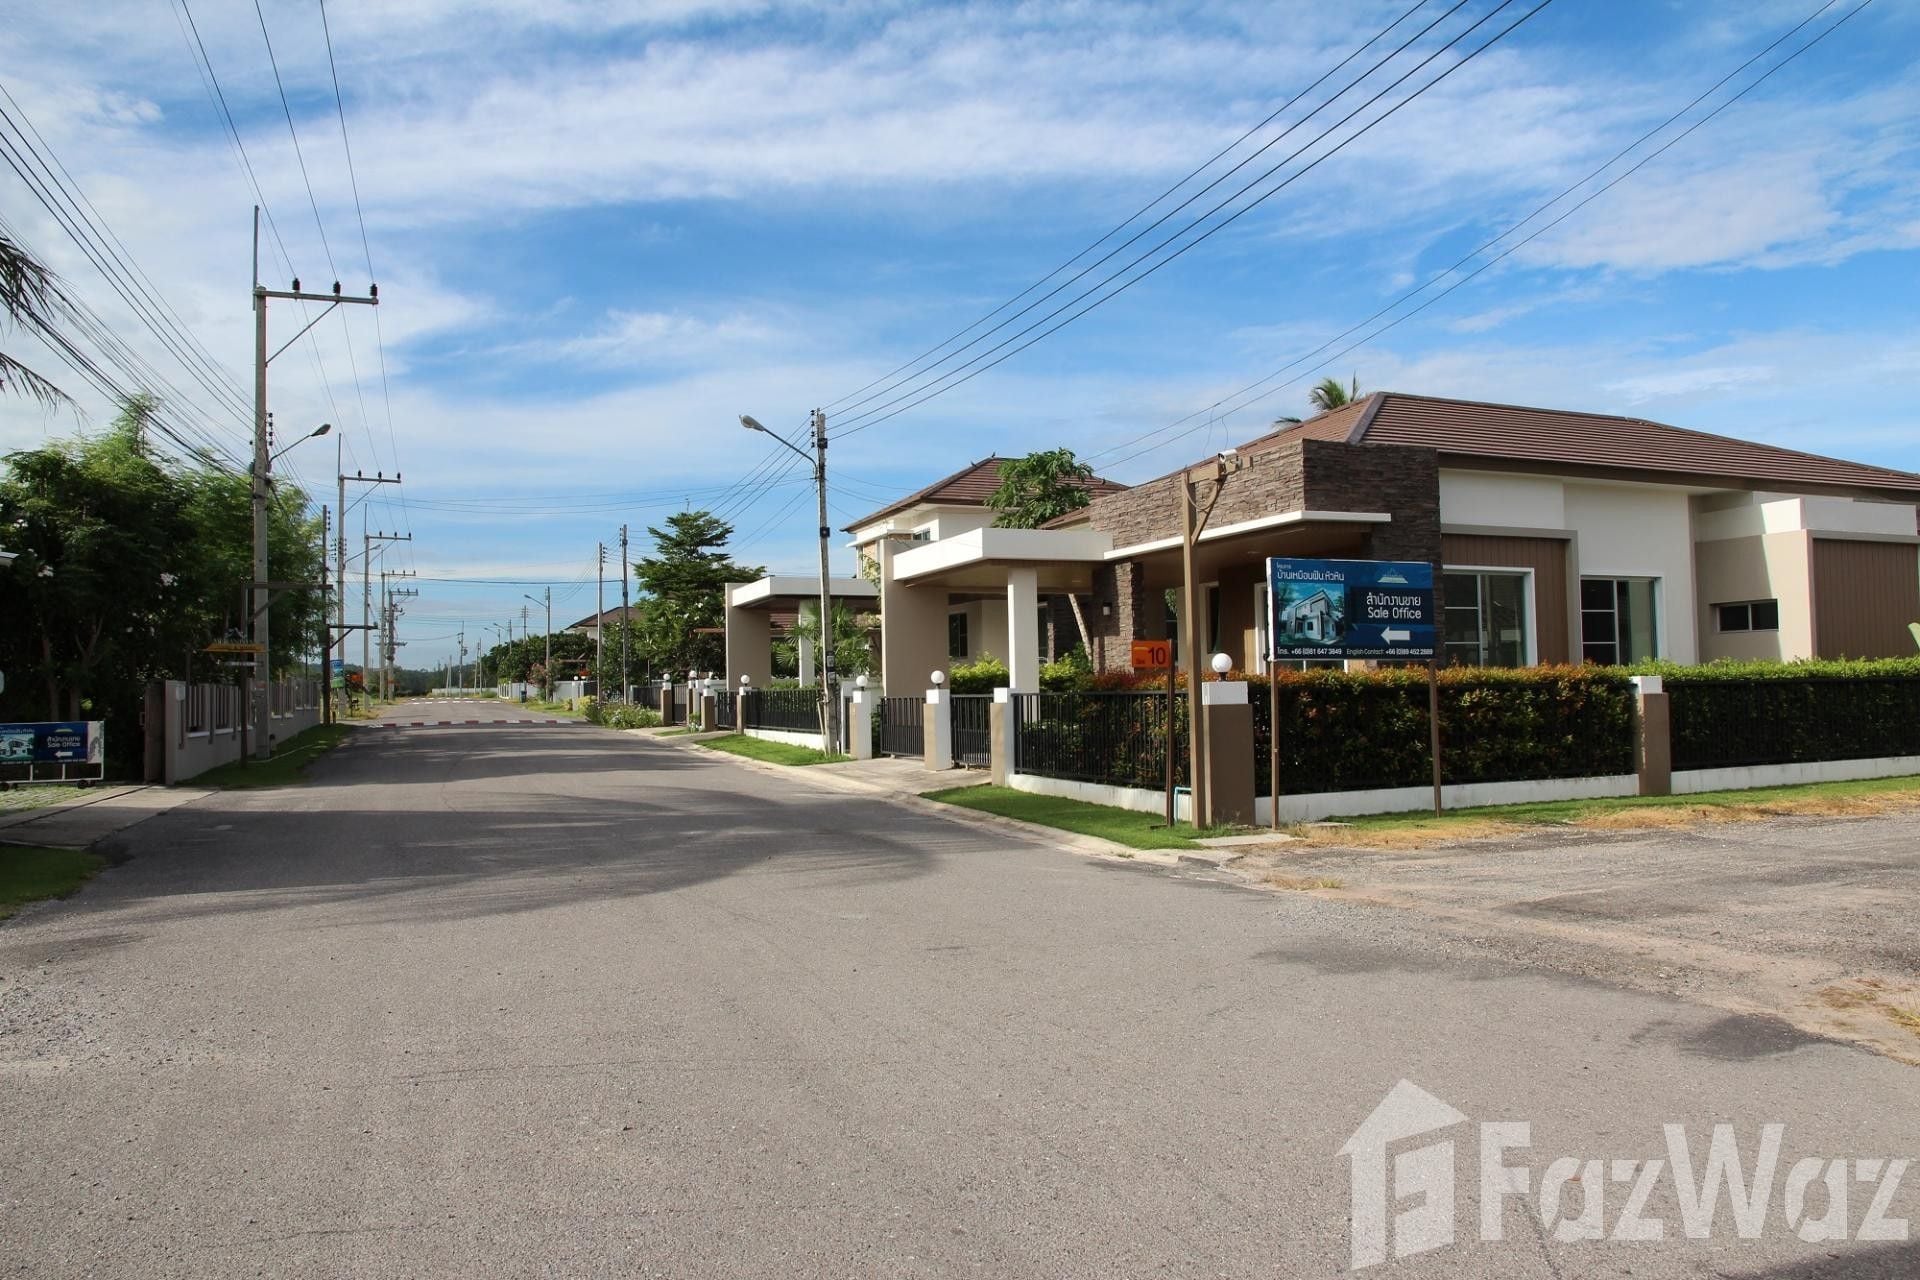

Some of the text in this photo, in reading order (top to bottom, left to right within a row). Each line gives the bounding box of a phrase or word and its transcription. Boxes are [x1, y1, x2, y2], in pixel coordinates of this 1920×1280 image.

[1366, 592, 1421, 606] สำนักงานขาย
[1367, 607, 1422, 619] Sale Office
[1147, 646, 1166, 665] 10
